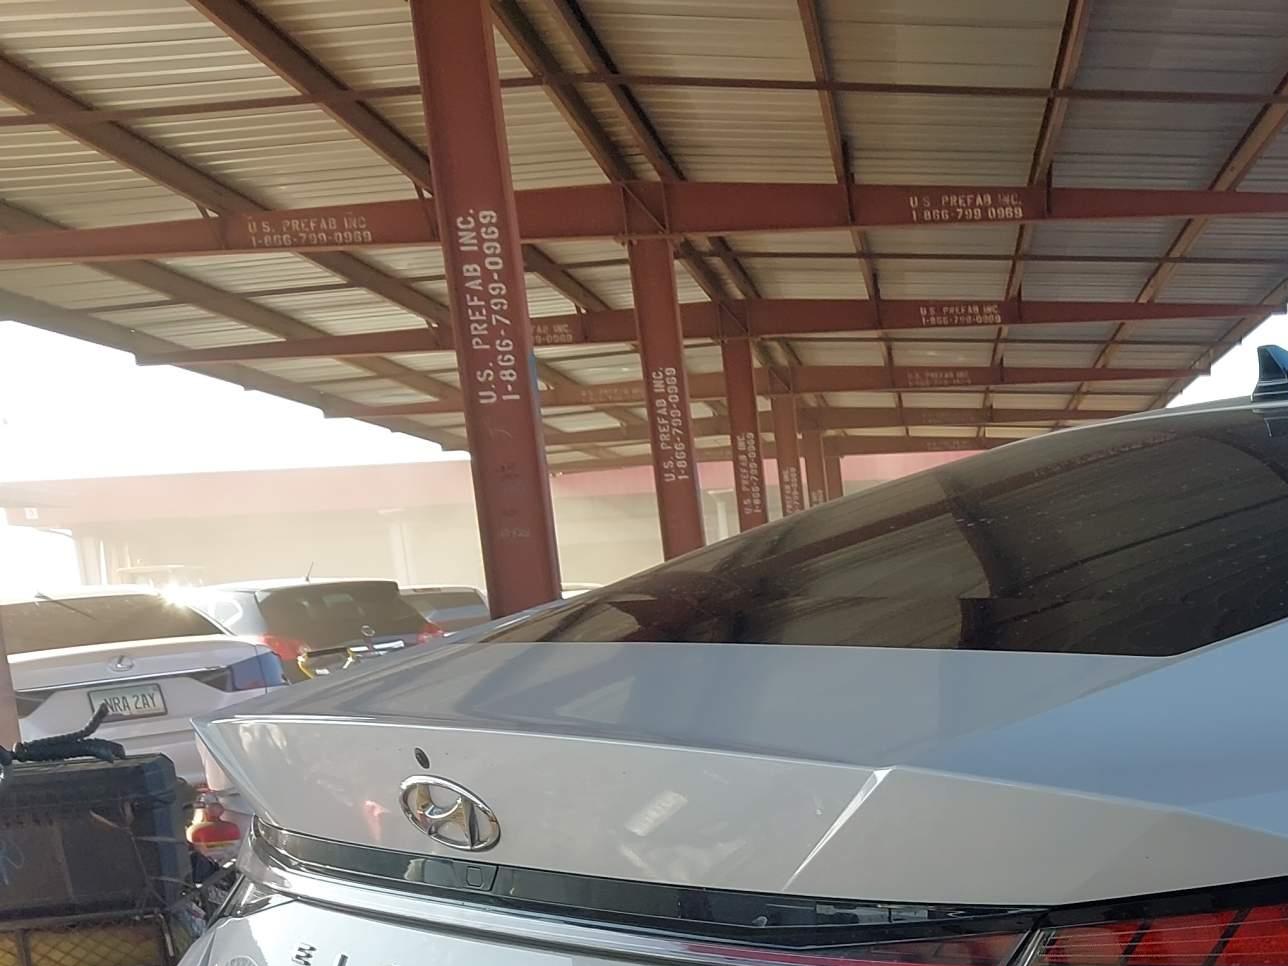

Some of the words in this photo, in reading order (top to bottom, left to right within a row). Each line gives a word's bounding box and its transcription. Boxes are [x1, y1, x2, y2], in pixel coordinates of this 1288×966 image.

[909, 196, 931, 208] US
[941, 193, 992, 207] PREFAB
[247, 220, 275, 233] US.
[281, 217, 337, 232] PREFAB
[912, 207, 1023, 222] 1866-7990969
[456, 208, 478, 251] INC.
[463, 263, 490, 350] PREFAB
[479, 210, 521, 400] 1-866-799-0969
[476, 362, 497, 404] U.S.
[652, 367, 665, 392] INC.
[655, 398, 672, 450] PREFAB
[663, 456, 676, 482] U.S.
[743, 499, 753, 515] U.S
[133, 692, 156, 710] 2AY
